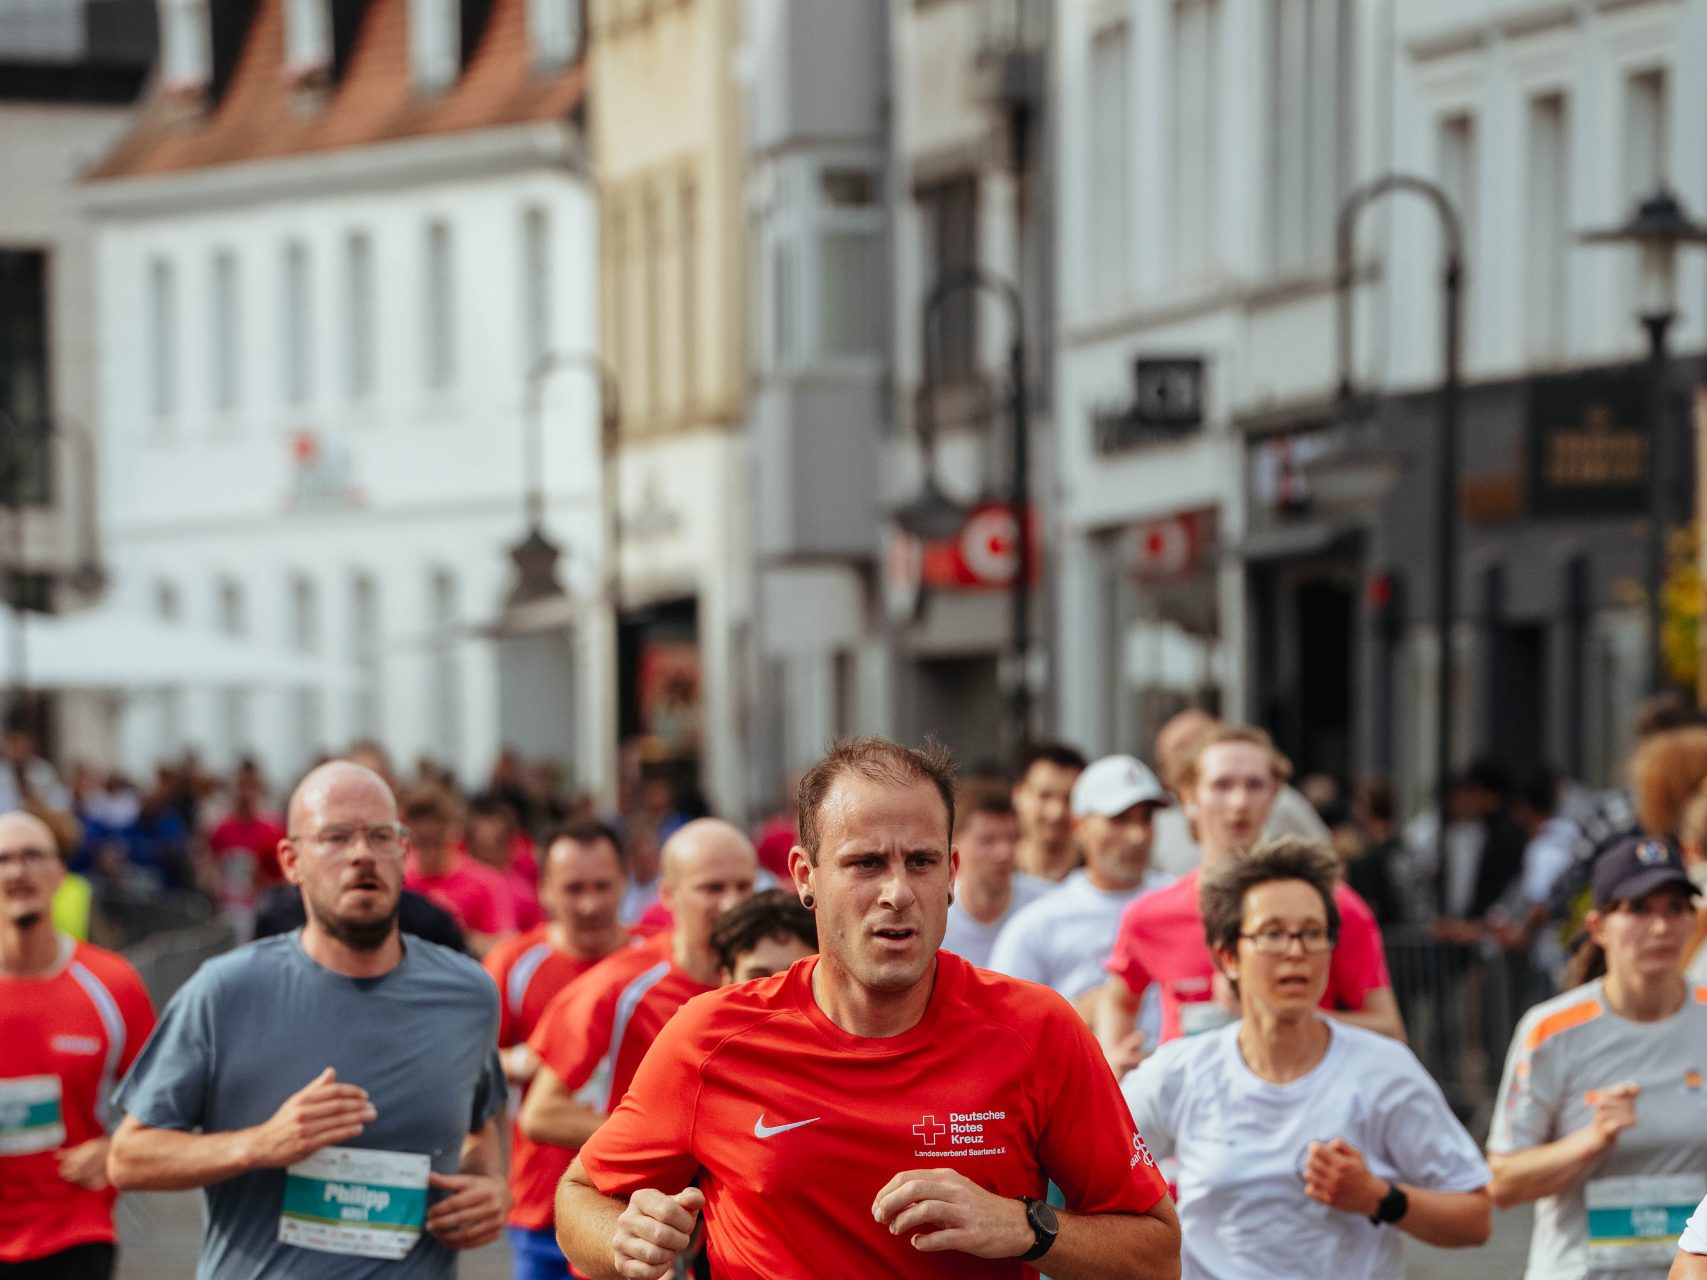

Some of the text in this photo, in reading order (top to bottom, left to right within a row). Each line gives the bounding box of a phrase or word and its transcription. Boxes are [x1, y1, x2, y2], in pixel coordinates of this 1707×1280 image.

[950, 1110, 1006, 1122] Deutsches
[950, 1123, 984, 1133] Rotes
[951, 1134, 984, 1144] Kreuz
[914, 1149, 968, 1157] Landesverband
[968, 1147, 997, 1156] Saarland
